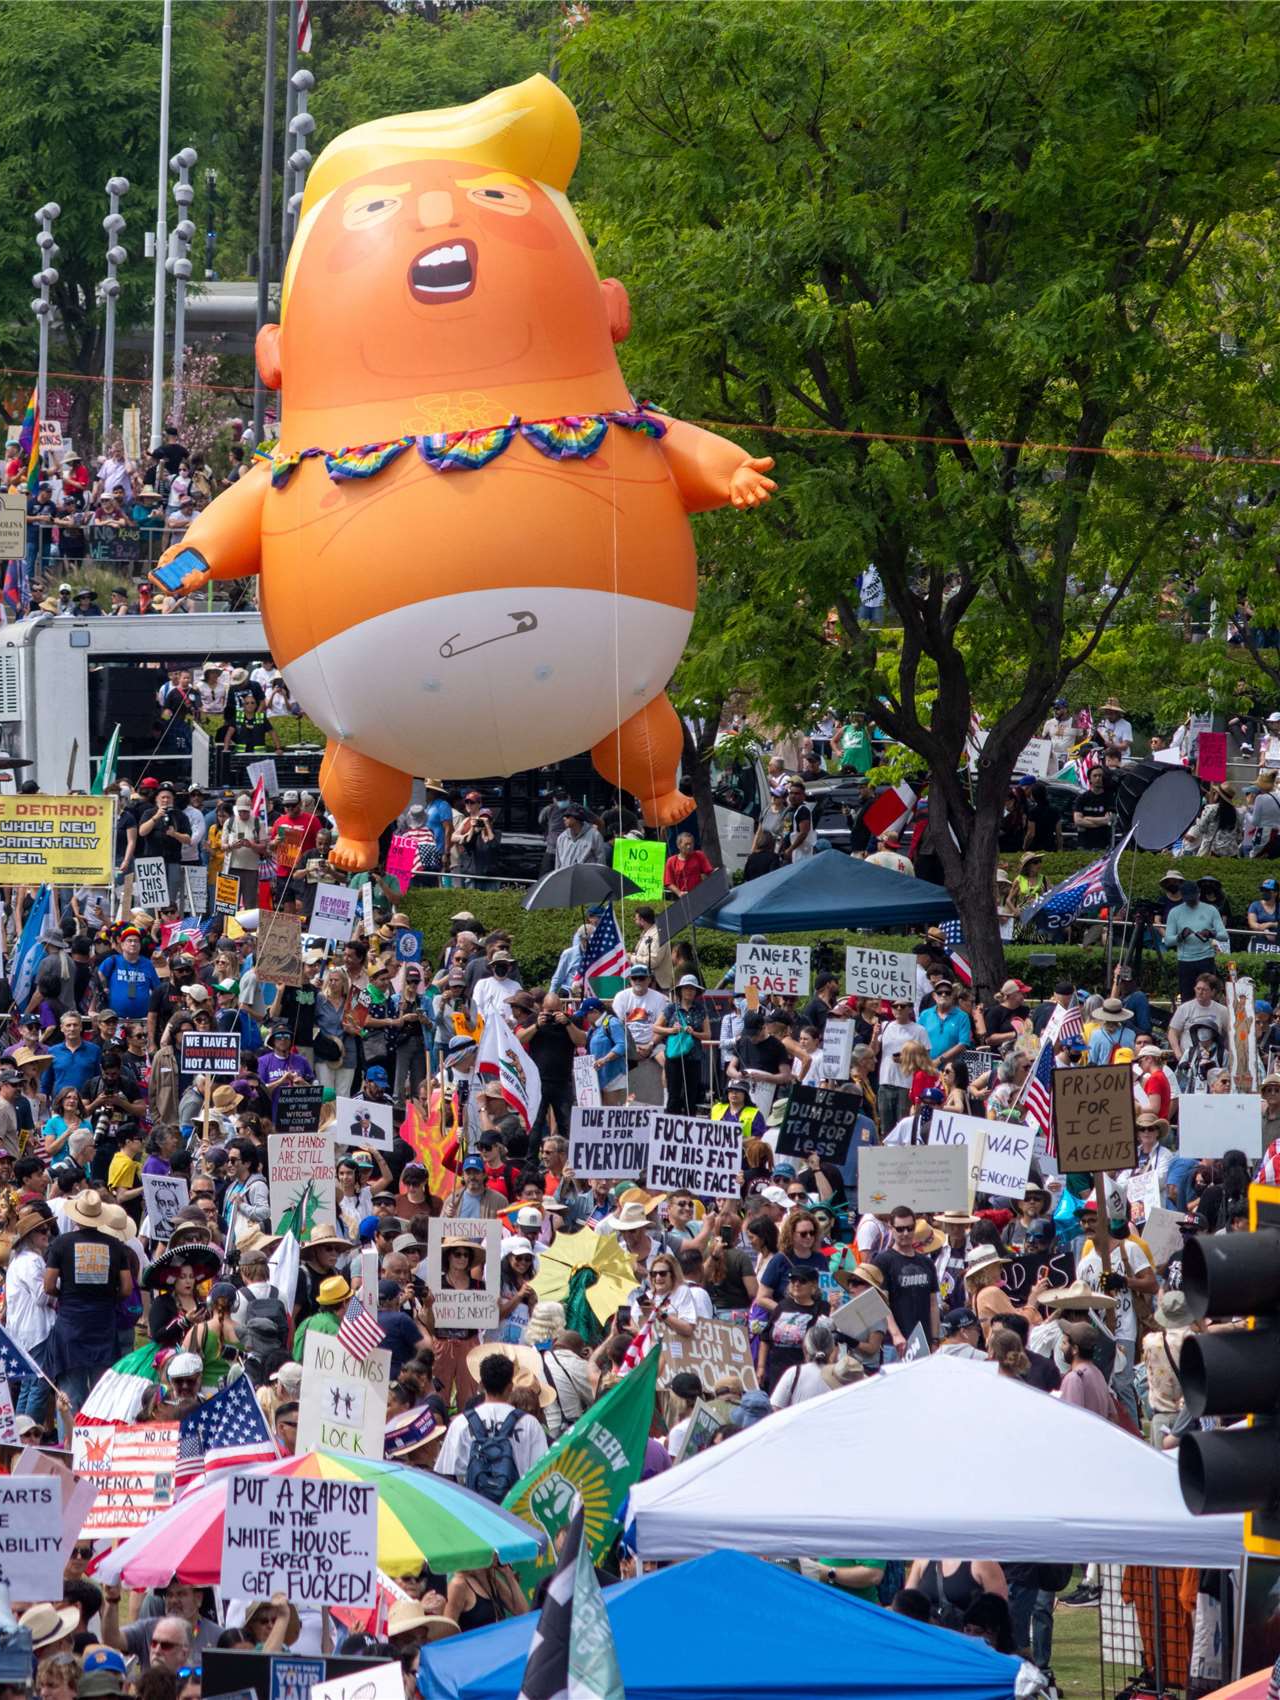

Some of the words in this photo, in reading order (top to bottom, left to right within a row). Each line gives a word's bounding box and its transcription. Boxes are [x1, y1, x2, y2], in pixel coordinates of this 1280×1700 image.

[16, 804, 104, 817] DEMAND:
[0, 820, 54, 833] WHOLE
[60, 821, 96, 833] NEW
[629, 848, 649, 861] NO
[138, 862, 163, 877] FUCK
[139, 877, 162, 890] THIS
[141, 890, 166, 905] SHIT
[320, 896, 351, 909] REMOVE
[749, 947, 809, 966] ANGER:
[857, 950, 899, 967] THIS
[762, 966, 784, 977] ALL
[788, 968, 803, 978] THE
[851, 966, 912, 984] SEQUEL
[750, 976, 798, 994] RAGE
[857, 980, 913, 998] SUCKS!
[186, 1036, 200, 1047] WE
[202, 1037, 228, 1048] HAVE
[230, 1037, 237, 1048] A
[185, 1048, 236, 1057] CONSTITUTION
[185, 1058, 203, 1069] NOT
[204, 1058, 212, 1069] A
[214, 1058, 236, 1070] KING
[815, 1091, 836, 1107] WE
[1077, 1099, 1110, 1115] FOR
[582, 1109, 604, 1127] DUE
[607, 1109, 658, 1128] PROCES
[790, 1102, 855, 1126] DUMPED
[602, 1130, 611, 1138] IS
[613, 1130, 633, 1138] FOR
[654, 1117, 693, 1145] FUCK
[695, 1123, 742, 1149] TRUMP
[786, 1120, 810, 1136] TEA
[819, 1124, 847, 1141] FOR
[1066, 1116, 1122, 1136] ICE
[280, 1136, 296, 1148] MY
[298, 1135, 327, 1149] HANDS
[987, 1134, 1029, 1161] WAR
[278, 1150, 296, 1164] ARE
[297, 1150, 324, 1164] STILL
[660, 1145, 677, 1161] IN
[681, 1147, 704, 1165] HIS
[706, 1150, 738, 1170] FAT
[1067, 1142, 1132, 1164] AGENTS
[272, 1166, 301, 1182] BIGGER
[311, 1165, 335, 1180] YOURS
[651, 1165, 702, 1190] FUCKING
[704, 1170, 737, 1195] FACE
[970, 1165, 1026, 1190] GENOCIDE
[443, 1223, 487, 1237] MISSING
[434, 1306, 456, 1320] WHO
[457, 1306, 465, 1320] IS
[468, 1306, 496, 1320] NEXT?
[314, 1347, 335, 1370] NO
[341, 1357, 385, 1383] KINGS
[74, 1429, 89, 1438] NO
[144, 1431, 156, 1442] NO
[159, 1431, 172, 1441] ICE
[321, 1425, 364, 1453] LOCK
[79, 1460, 111, 1472] KINGS
[88, 1474, 143, 1490] AMERICA
[107, 1494, 116, 1505] IS
[122, 1494, 134, 1506] A
[233, 1477, 269, 1506] PUT
[276, 1478, 294, 1502] A
[301, 1479, 376, 1515] RAPIST
[269, 1511, 286, 1525] IN
[289, 1512, 318, 1526] THE
[228, 1528, 280, 1549] WHITE
[292, 1530, 369, 1556] HOUSE...
[260, 1552, 309, 1572] EXPECT
[313, 1555, 332, 1573] TO
[242, 1572, 275, 1594] GET
[287, 1572, 370, 1602] FUCKED!
